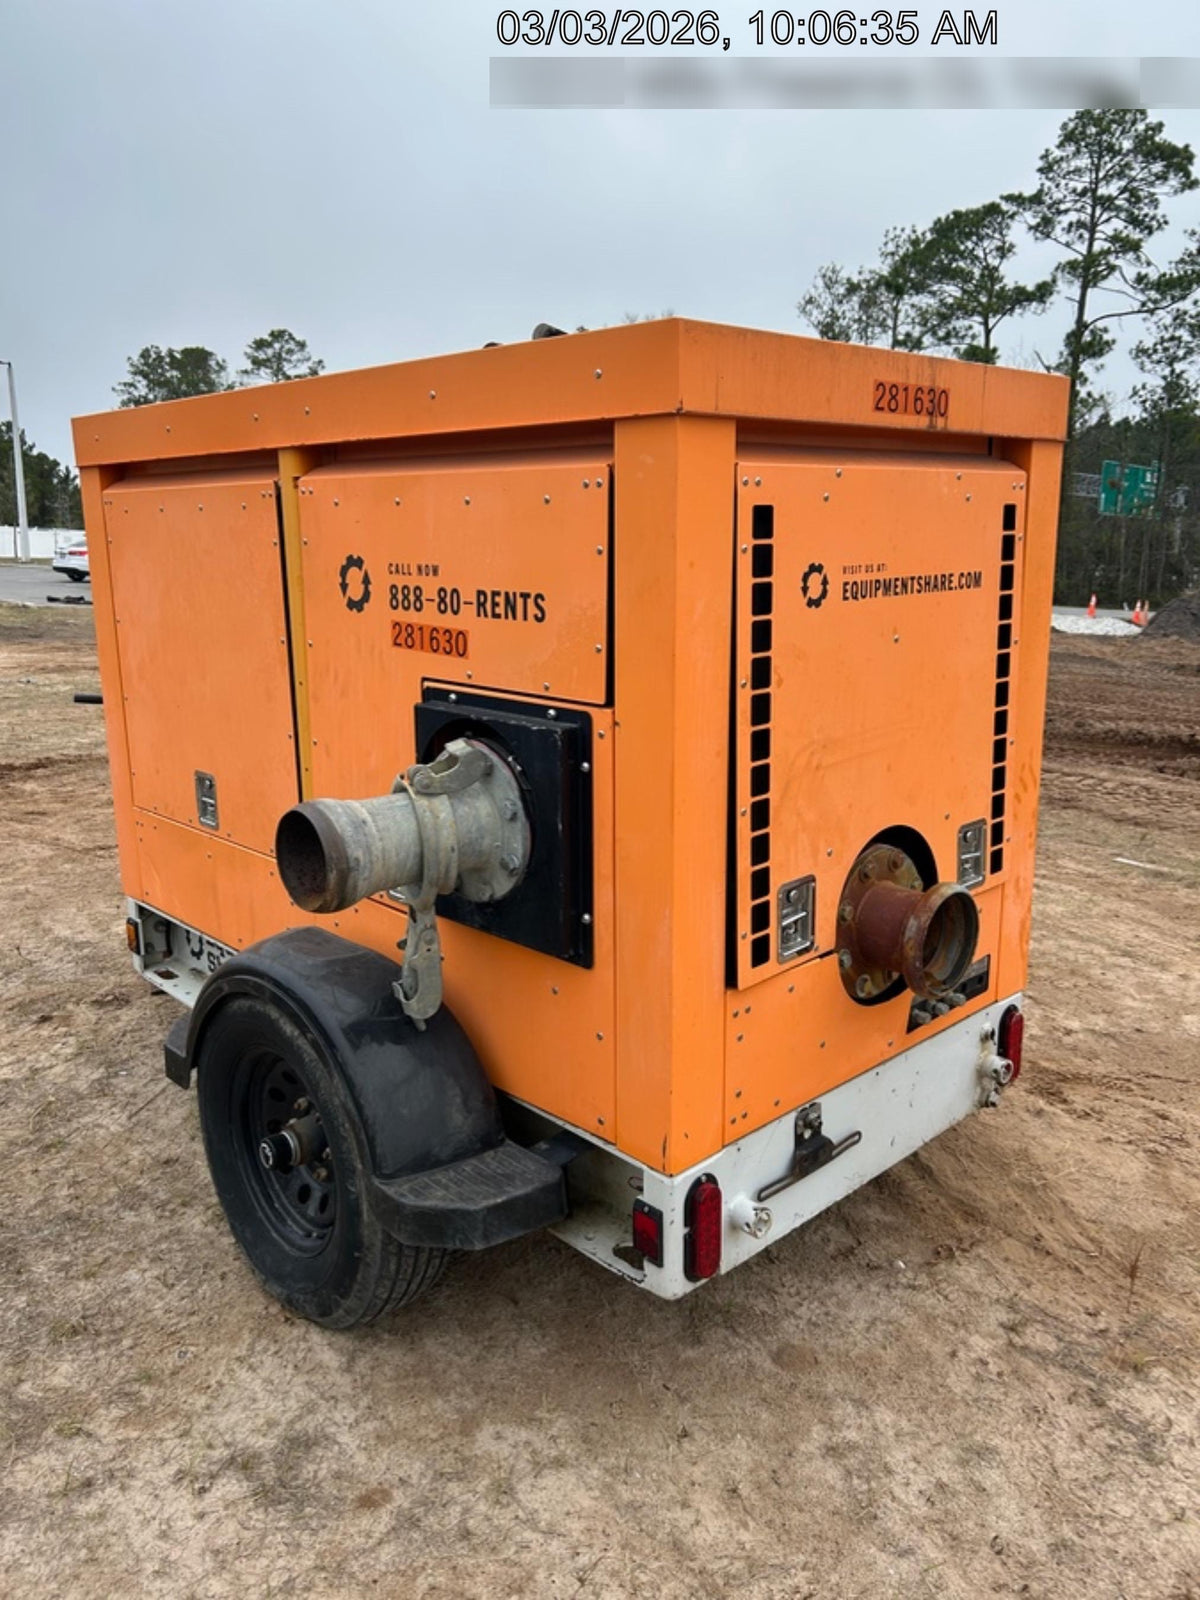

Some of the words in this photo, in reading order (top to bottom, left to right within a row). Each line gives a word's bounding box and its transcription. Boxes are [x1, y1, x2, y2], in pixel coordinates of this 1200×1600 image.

[875, 382, 949, 417] 281630
[387, 563, 412, 576] CALL
[416, 564, 440, 577] NOW
[842, 564, 862, 575] VISIT
[865, 563, 874, 574] US
[842, 571, 982, 601] EQUIPMENTSHARE.COM
[389, 584, 546, 623] 888-80-RENTS
[391, 622, 468, 658] 281630
